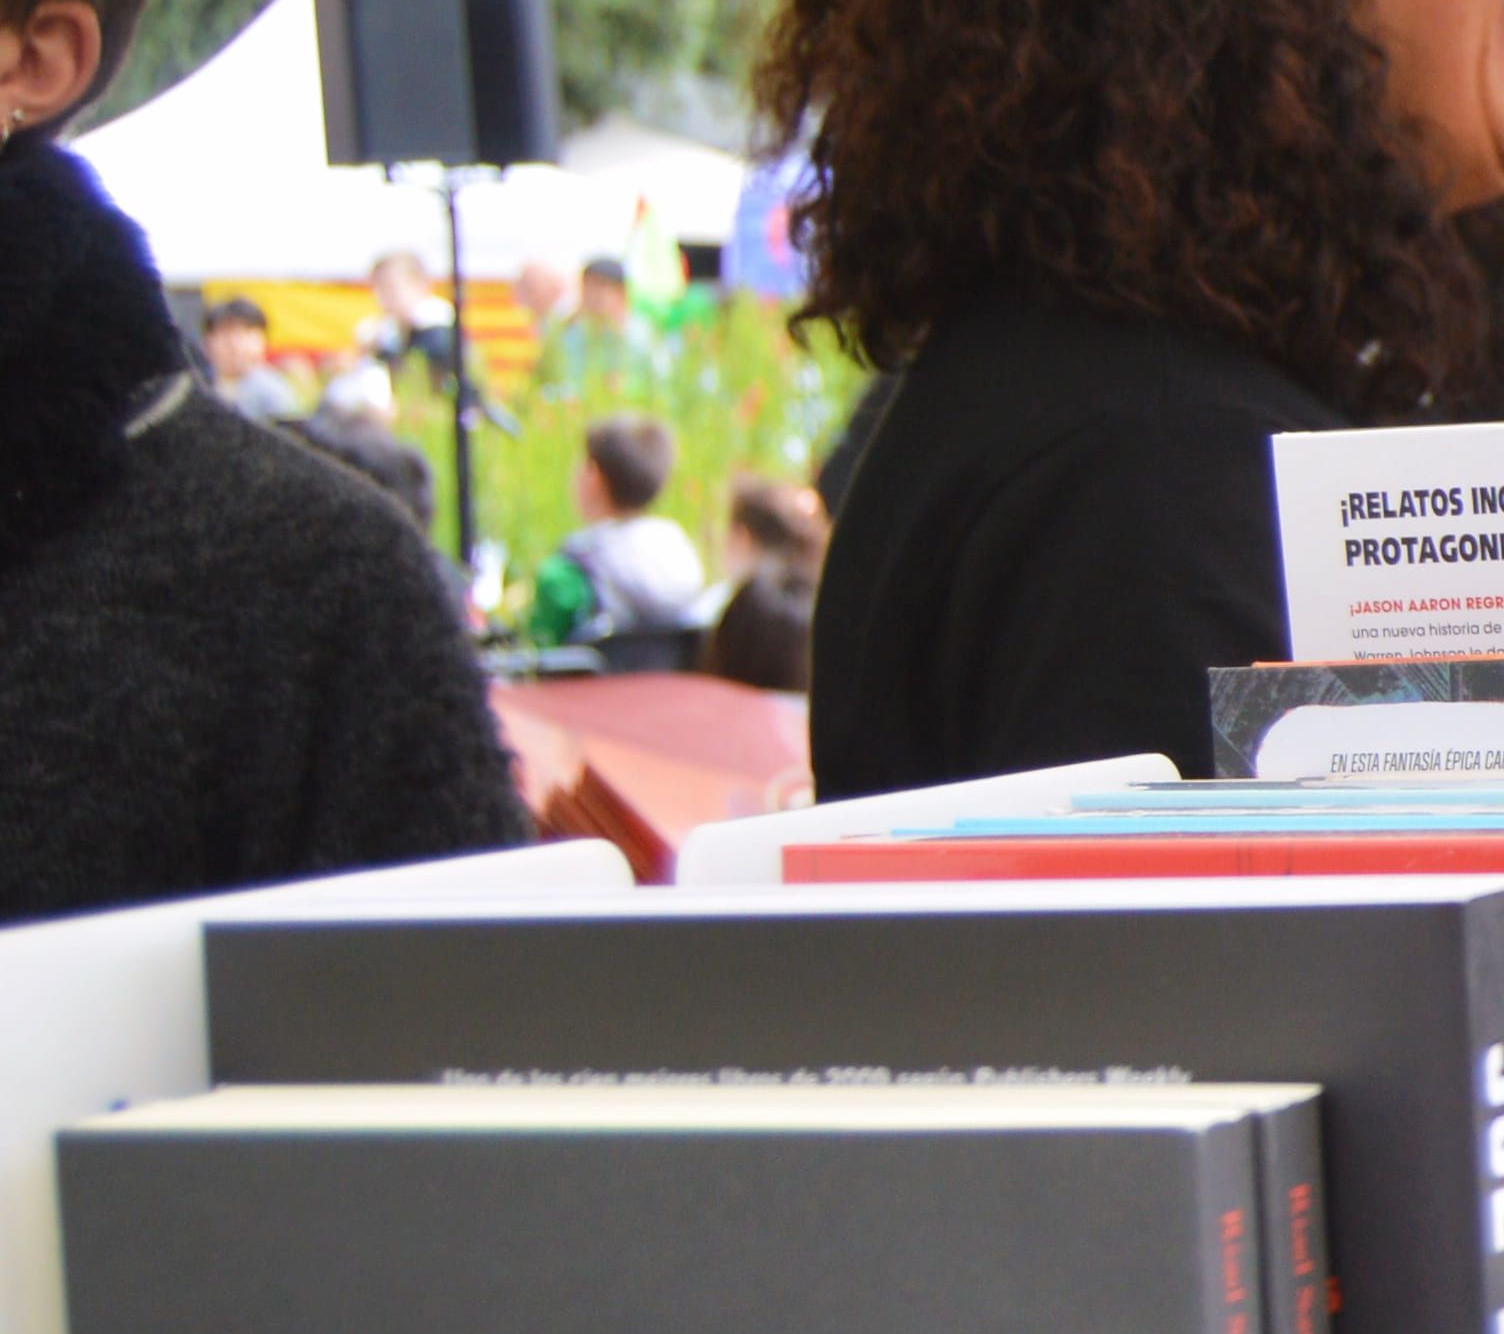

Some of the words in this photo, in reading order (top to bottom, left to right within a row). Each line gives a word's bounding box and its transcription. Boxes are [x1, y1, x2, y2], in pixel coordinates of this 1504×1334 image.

[1341, 487, 1463, 527] ¡RELATOS
[1350, 595, 1404, 618] ¡JASON
[1408, 595, 1462, 613] AARON
[1331, 753, 1348, 773] EN
[1350, 753, 1380, 772] ESTA
[1383, 749, 1441, 771] FANTASÍA
[1445, 747, 1480, 770] ÉPICA
